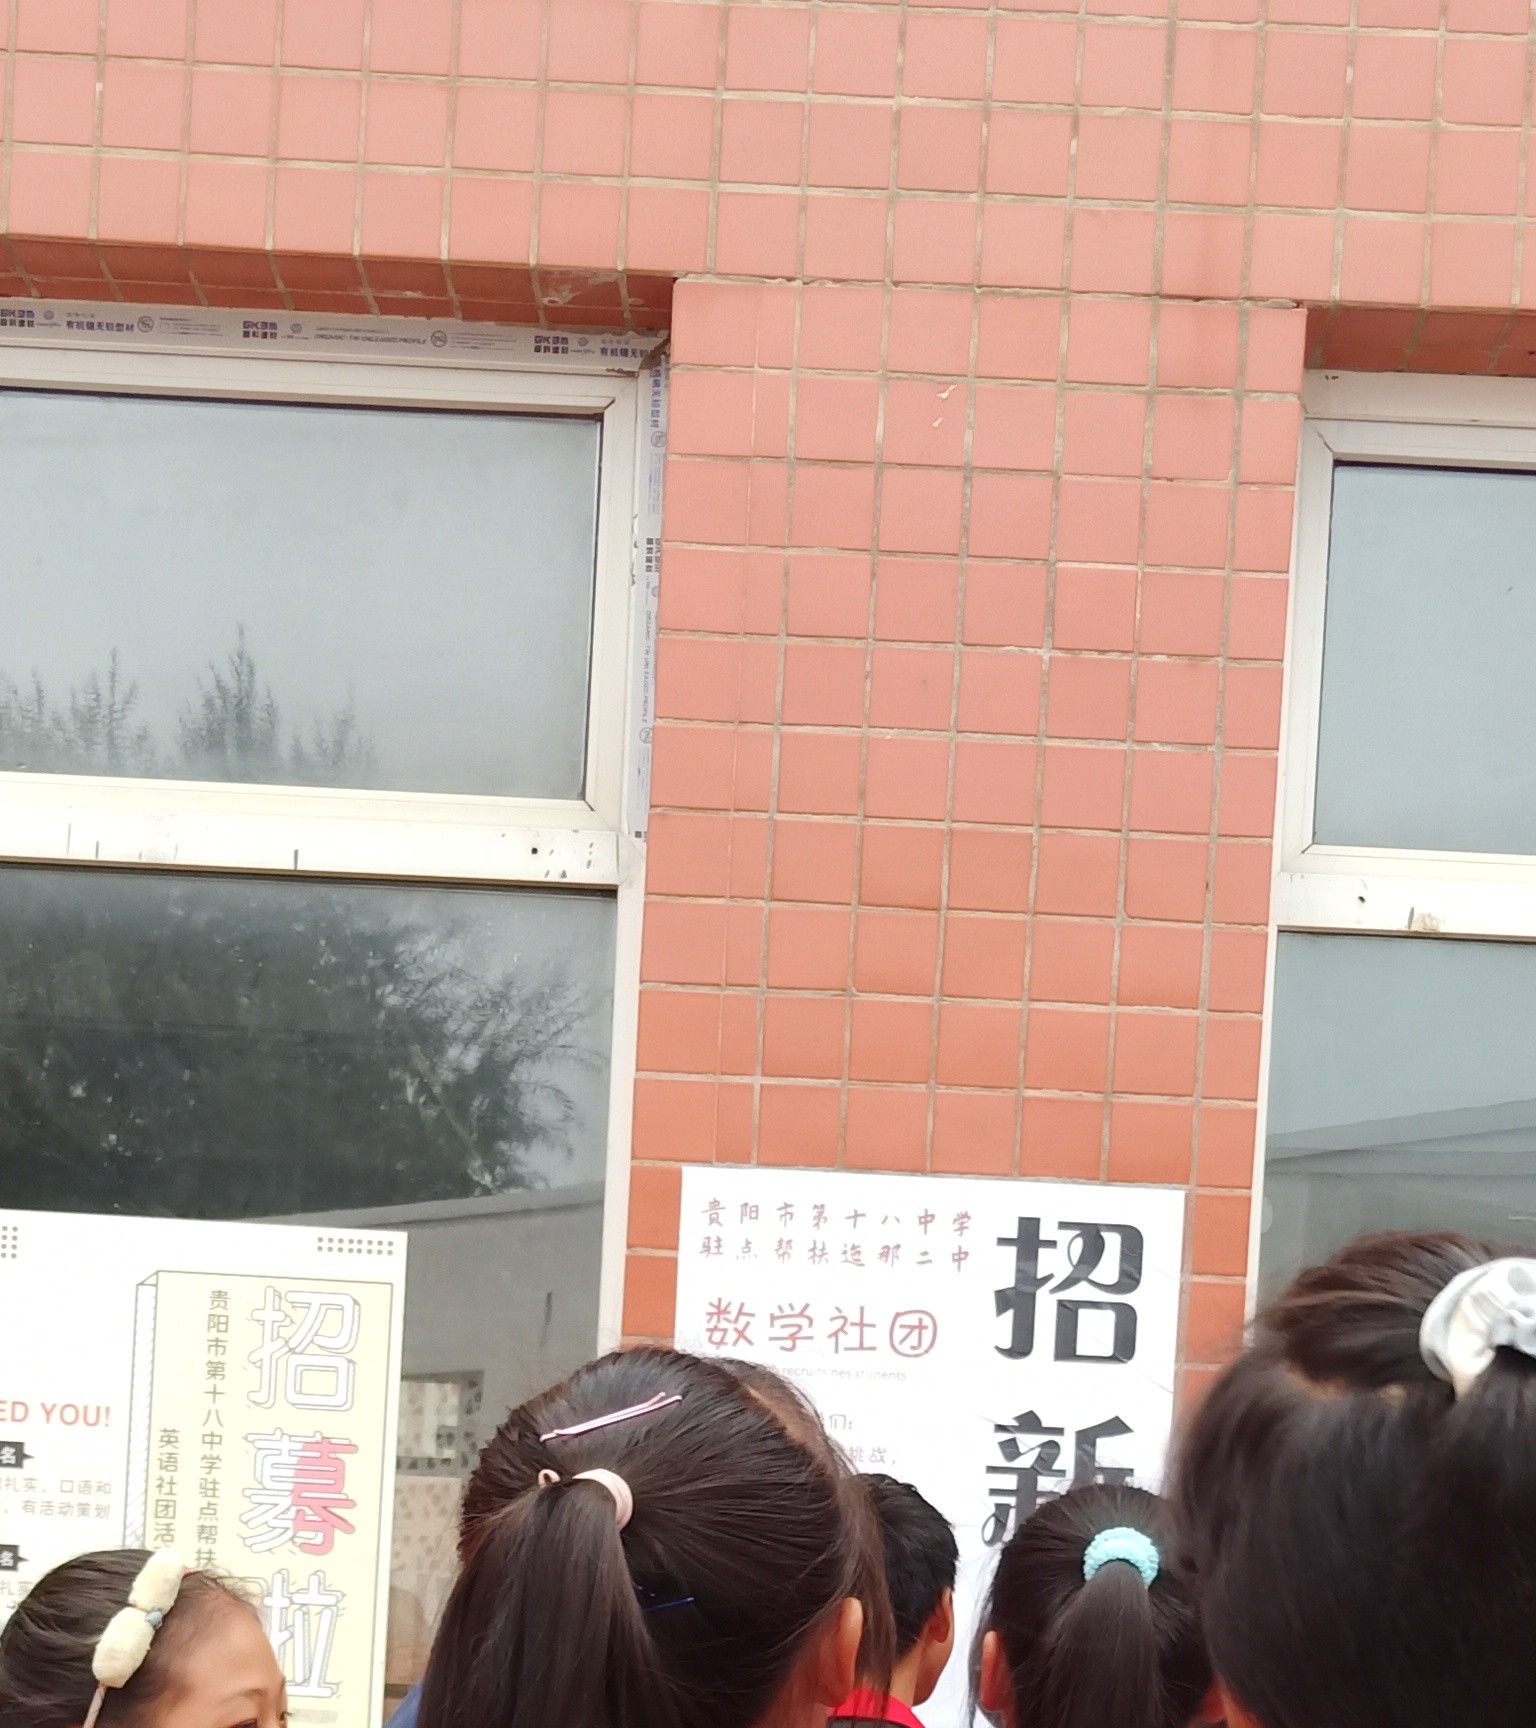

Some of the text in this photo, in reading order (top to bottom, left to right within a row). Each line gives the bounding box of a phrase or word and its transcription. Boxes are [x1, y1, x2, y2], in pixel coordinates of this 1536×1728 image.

[700, 1197, 972, 1238] 贵阳市第十八中学
[698, 1234, 972, 1273] 驻点帮扶迤那二中
[705, 1298, 938, 1359] 数学社团
[980, 1215, 1144, 1548] 招新
[40, 1402, 112, 1428] YOU!
[153, 1428, 180, 1549] 英语社团活
